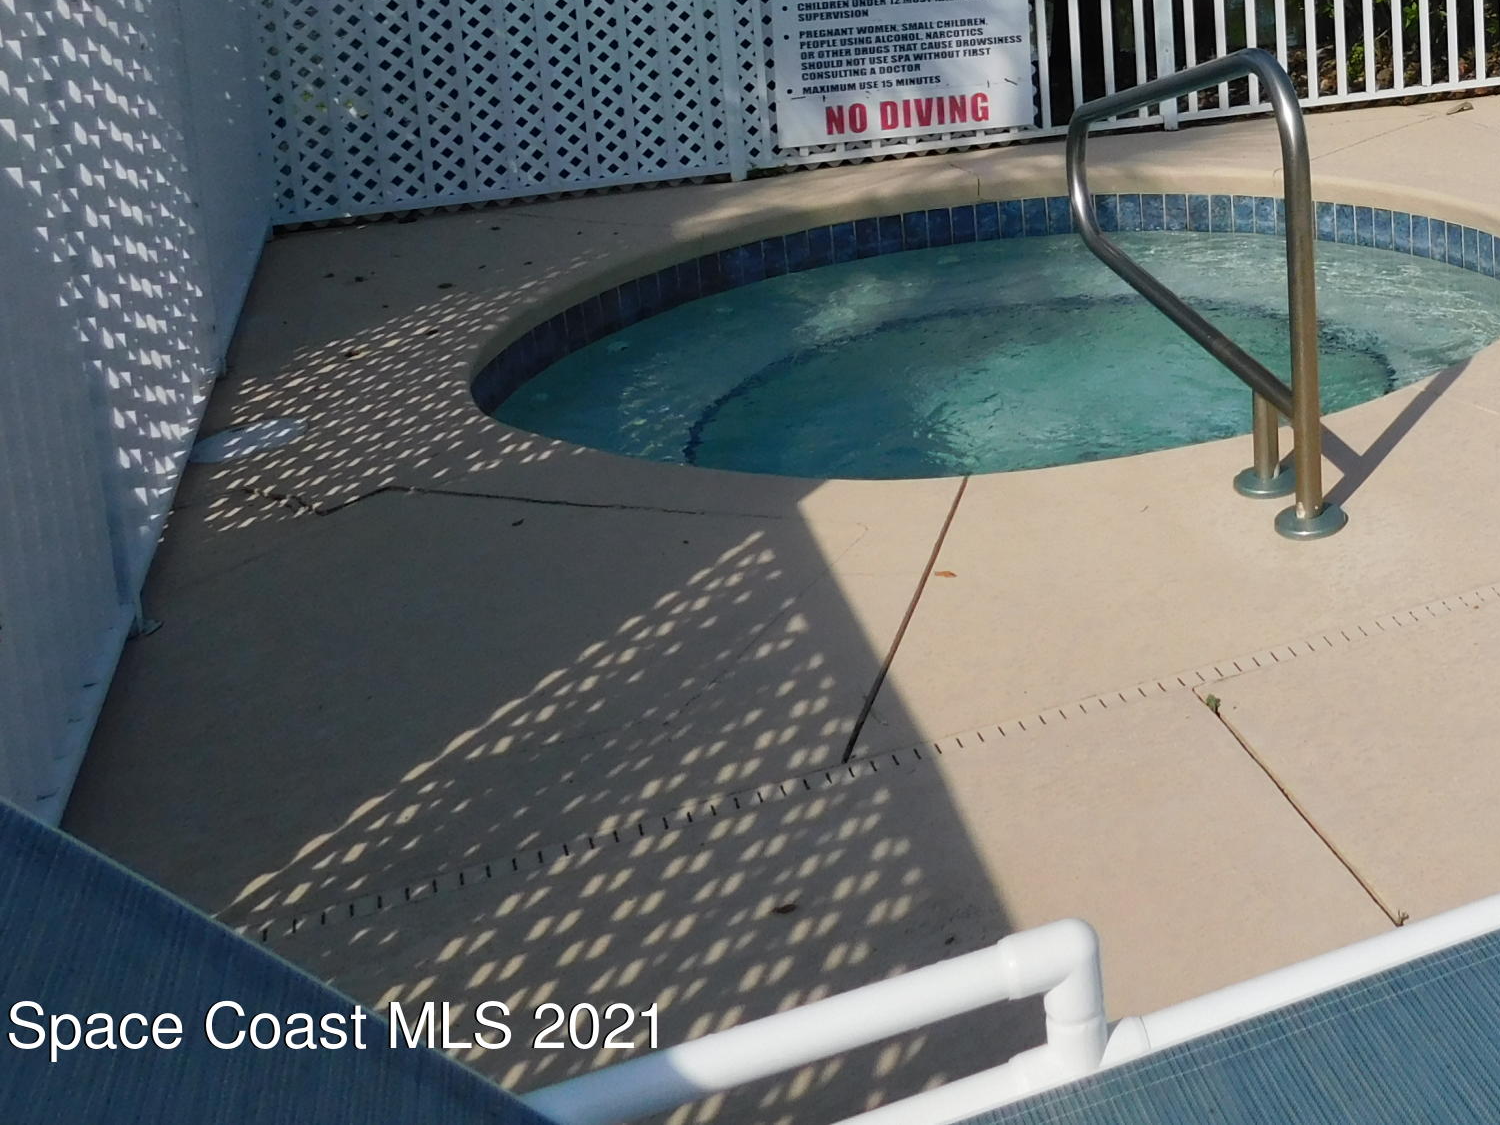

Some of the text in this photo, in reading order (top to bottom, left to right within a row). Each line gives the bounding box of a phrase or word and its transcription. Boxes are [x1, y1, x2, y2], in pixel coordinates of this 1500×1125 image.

[797, 0, 849, 11] CHILDREN
[798, 10, 869, 22] SUPERVISION
[800, 27, 853, 39] PREGNANT
[902, 22, 934, 32] SMALL
[800, 39, 837, 49] PEOPLE
[840, 36, 872, 46] USING
[926, 28, 983, 40] NARCOTICS
[801, 35, 1022, 60] OR OTHER DRUGS THAT CAUSE DROWSINESS
[802, 48, 991, 70] SHOULD NOT USE SPA WITHOUT FIRST
[802, 64, 920, 81] CONSULTING A DOCTOR
[803, 76, 941, 95] MAXIMUM USE 15 MINUTES
[826, 93, 989, 135] NO DIVING
